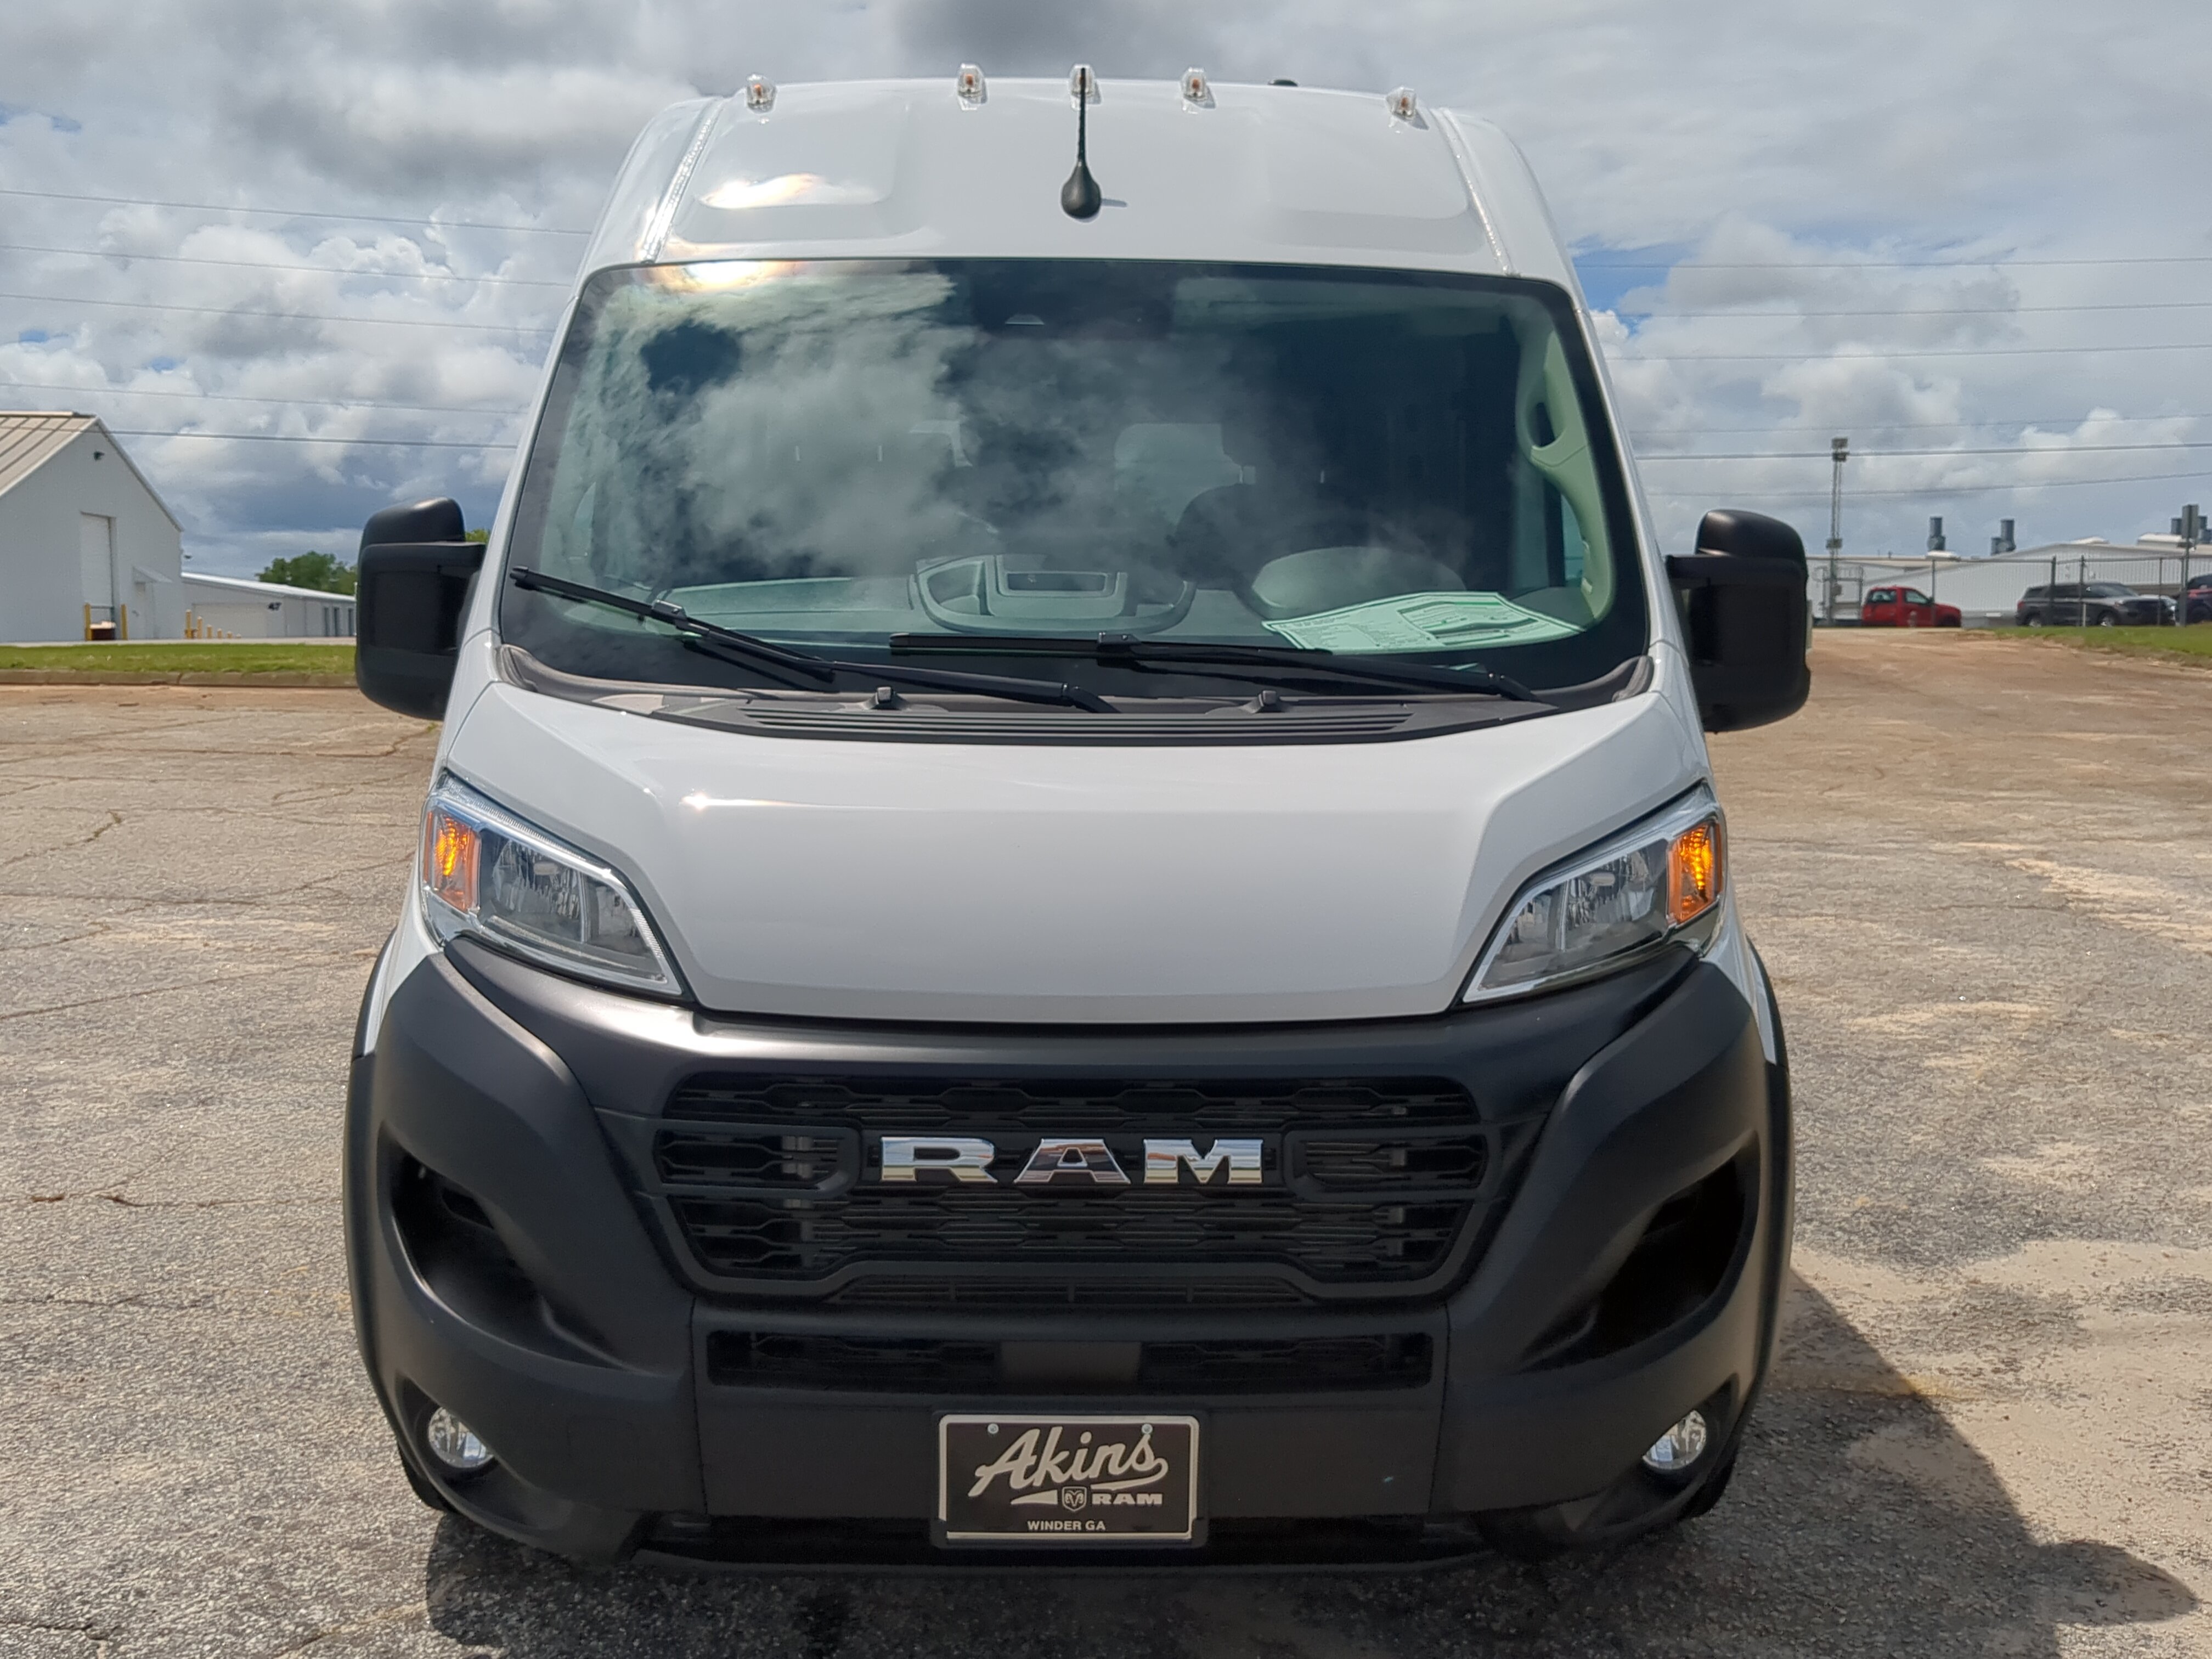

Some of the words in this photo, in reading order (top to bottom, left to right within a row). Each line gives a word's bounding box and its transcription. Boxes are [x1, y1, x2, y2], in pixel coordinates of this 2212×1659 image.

[881, 1137, 1262, 1184] RAM
[968, 1426, 1168, 1497] Akins
[1092, 1493, 1163, 1505] RAM
[1028, 1521, 1082, 1531] WINDER
[1085, 1521, 1106, 1531] GA
